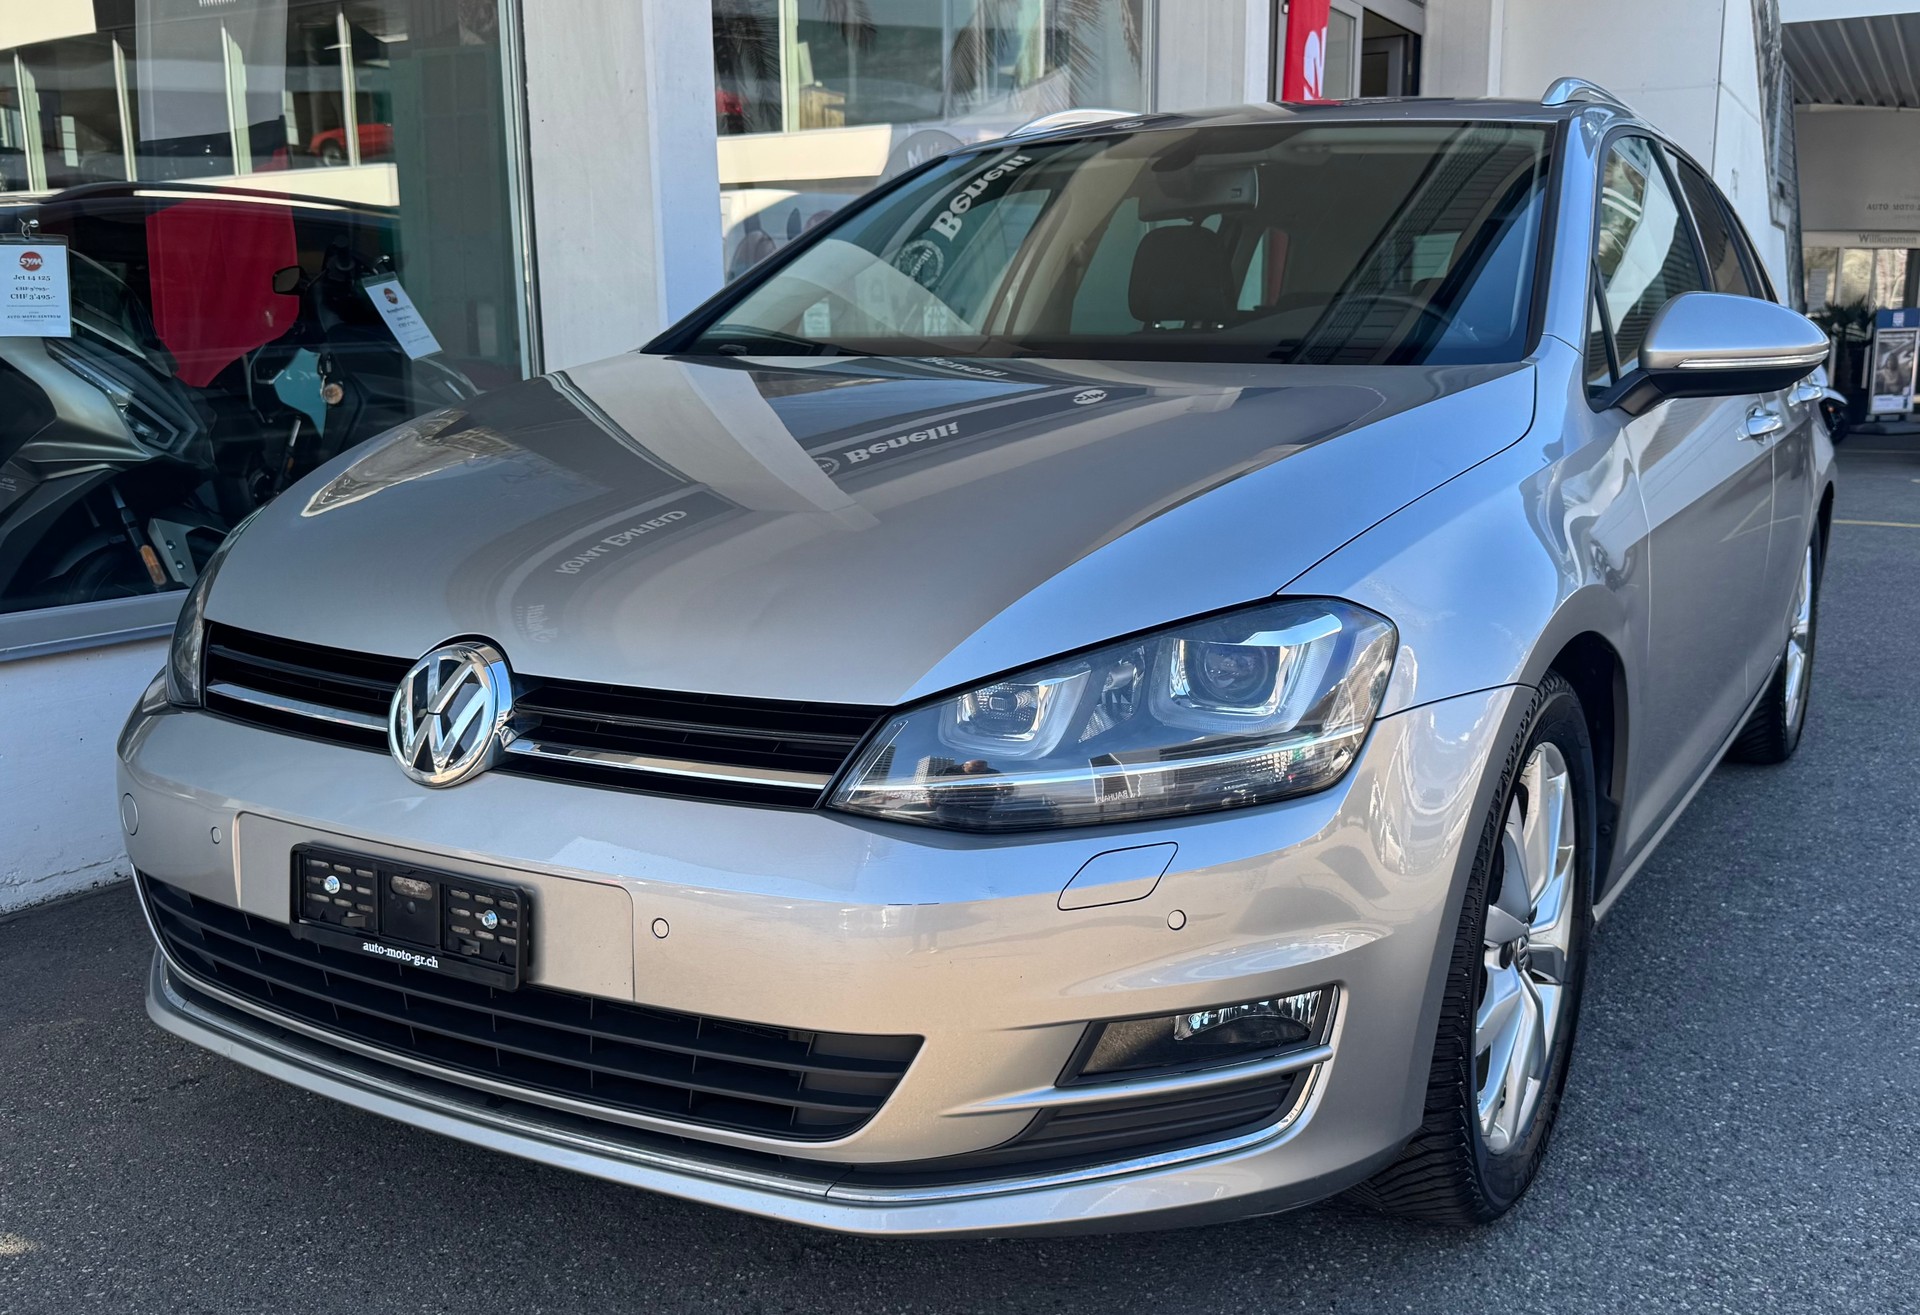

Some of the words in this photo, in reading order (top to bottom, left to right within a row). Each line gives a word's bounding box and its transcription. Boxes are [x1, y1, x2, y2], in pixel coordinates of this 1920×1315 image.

[1858, 233, 1917, 244] Willkommen
[19, 257, 43, 268] SYM
[362, 941, 439, 969] auto-moto-gr.ch
